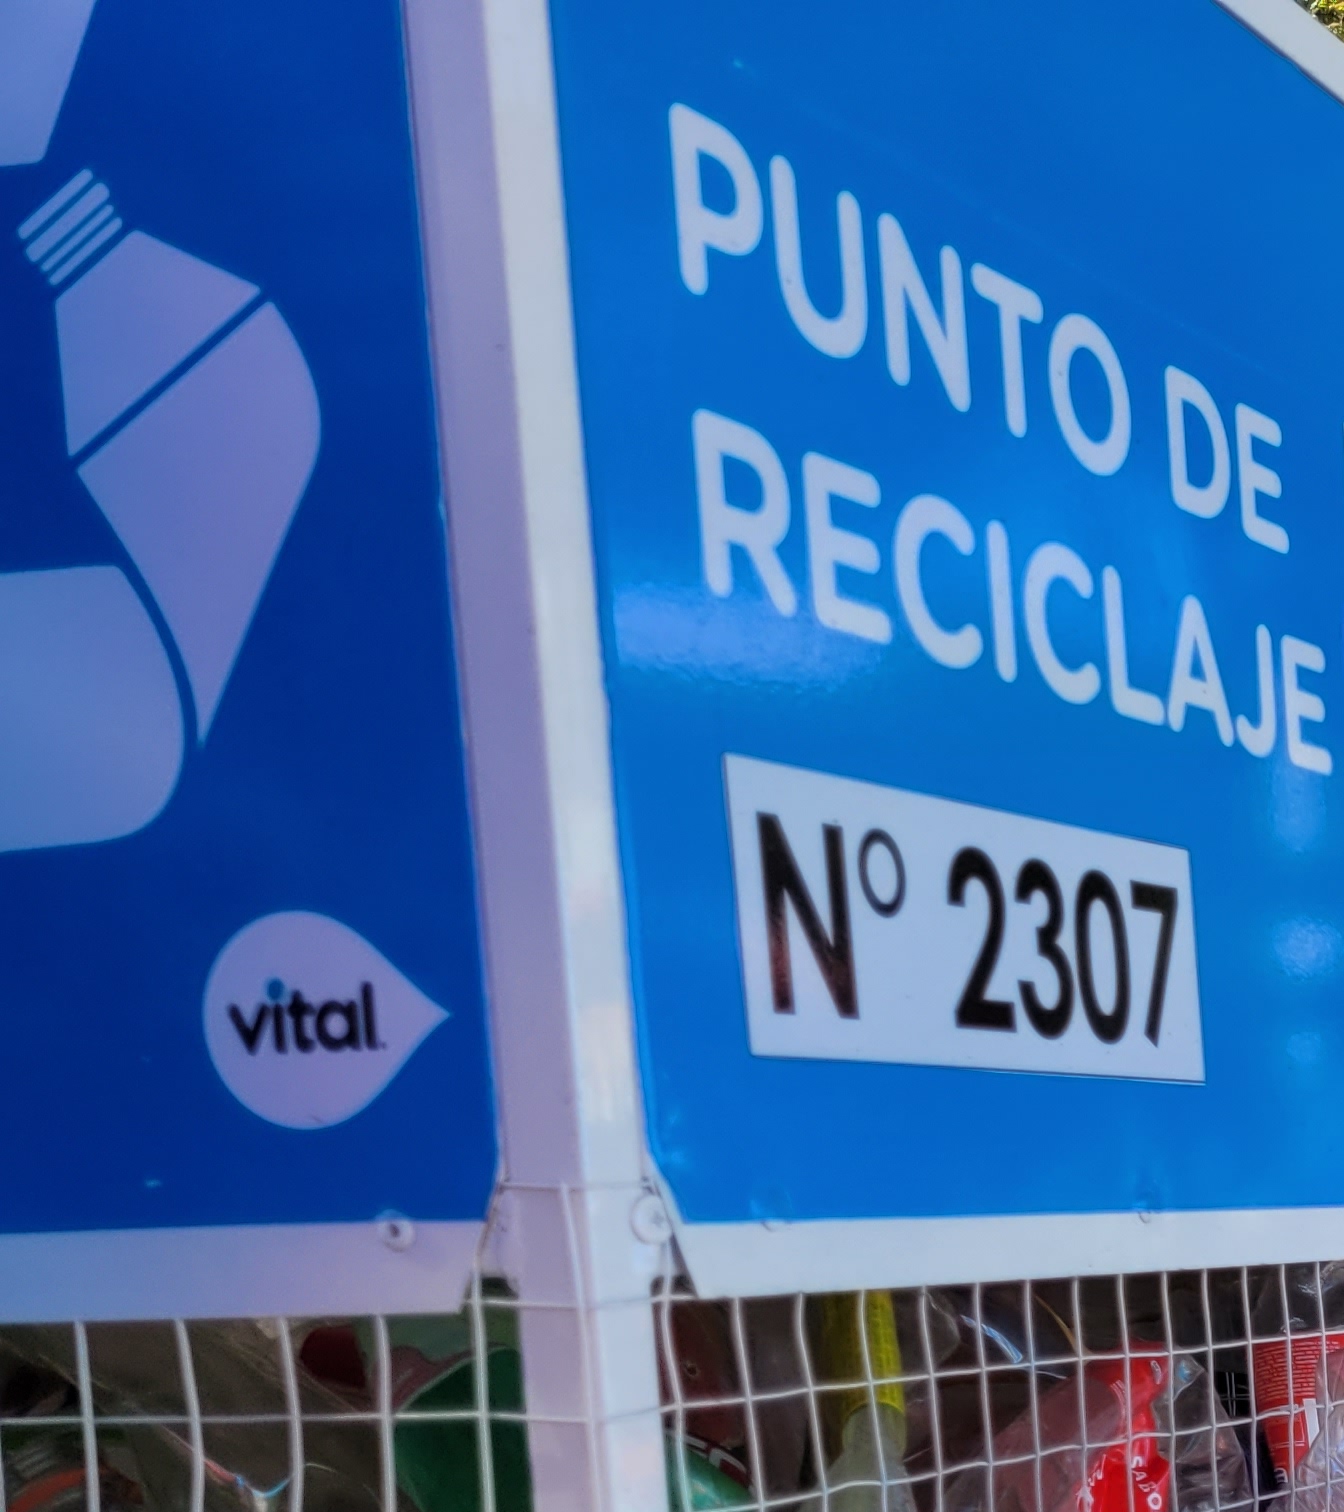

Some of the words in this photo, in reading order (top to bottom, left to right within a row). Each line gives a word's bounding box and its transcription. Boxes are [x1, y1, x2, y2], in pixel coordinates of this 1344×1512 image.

[667, 103, 1131, 476] PUNTO
[1164, 366, 1290, 554] DE
[691, 409, 1333, 776] RECICLAJE
[228, 978, 382, 1056] vital
[948, 847, 1178, 1048] 2307
